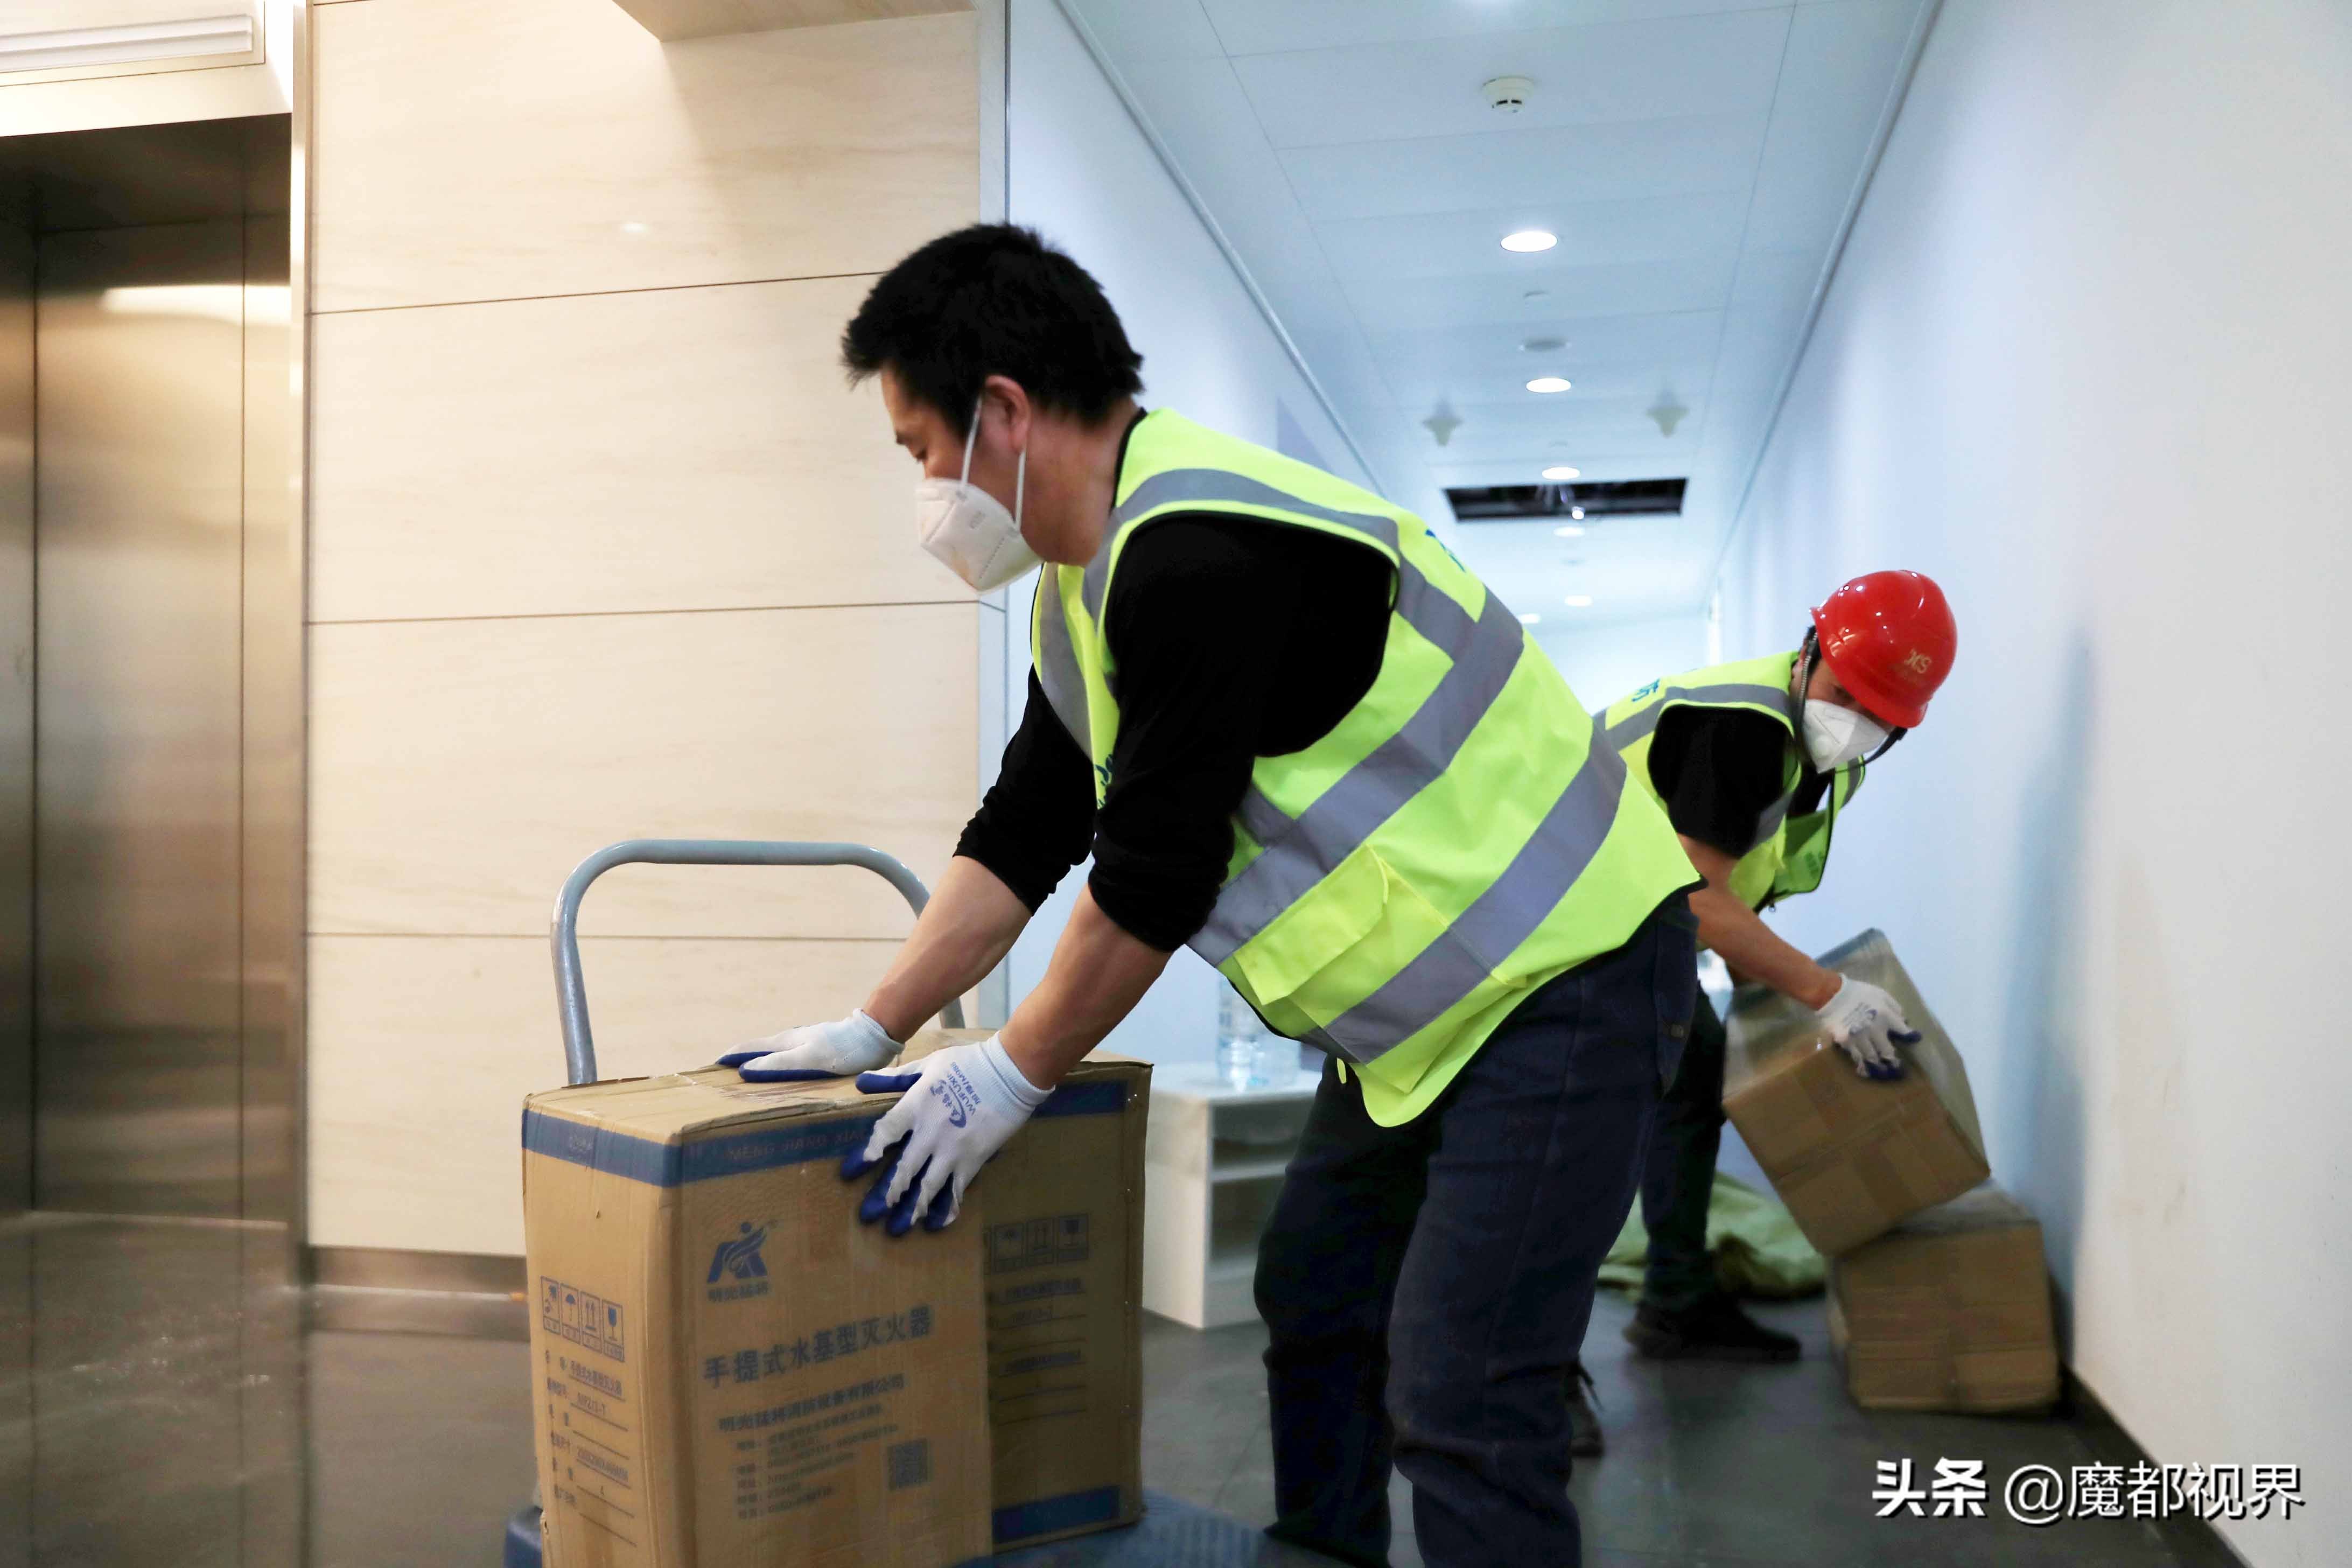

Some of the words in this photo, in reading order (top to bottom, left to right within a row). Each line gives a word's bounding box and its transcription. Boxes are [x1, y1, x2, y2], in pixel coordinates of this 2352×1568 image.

[704, 1305, 932, 1389] 手提式水基型灭火器
